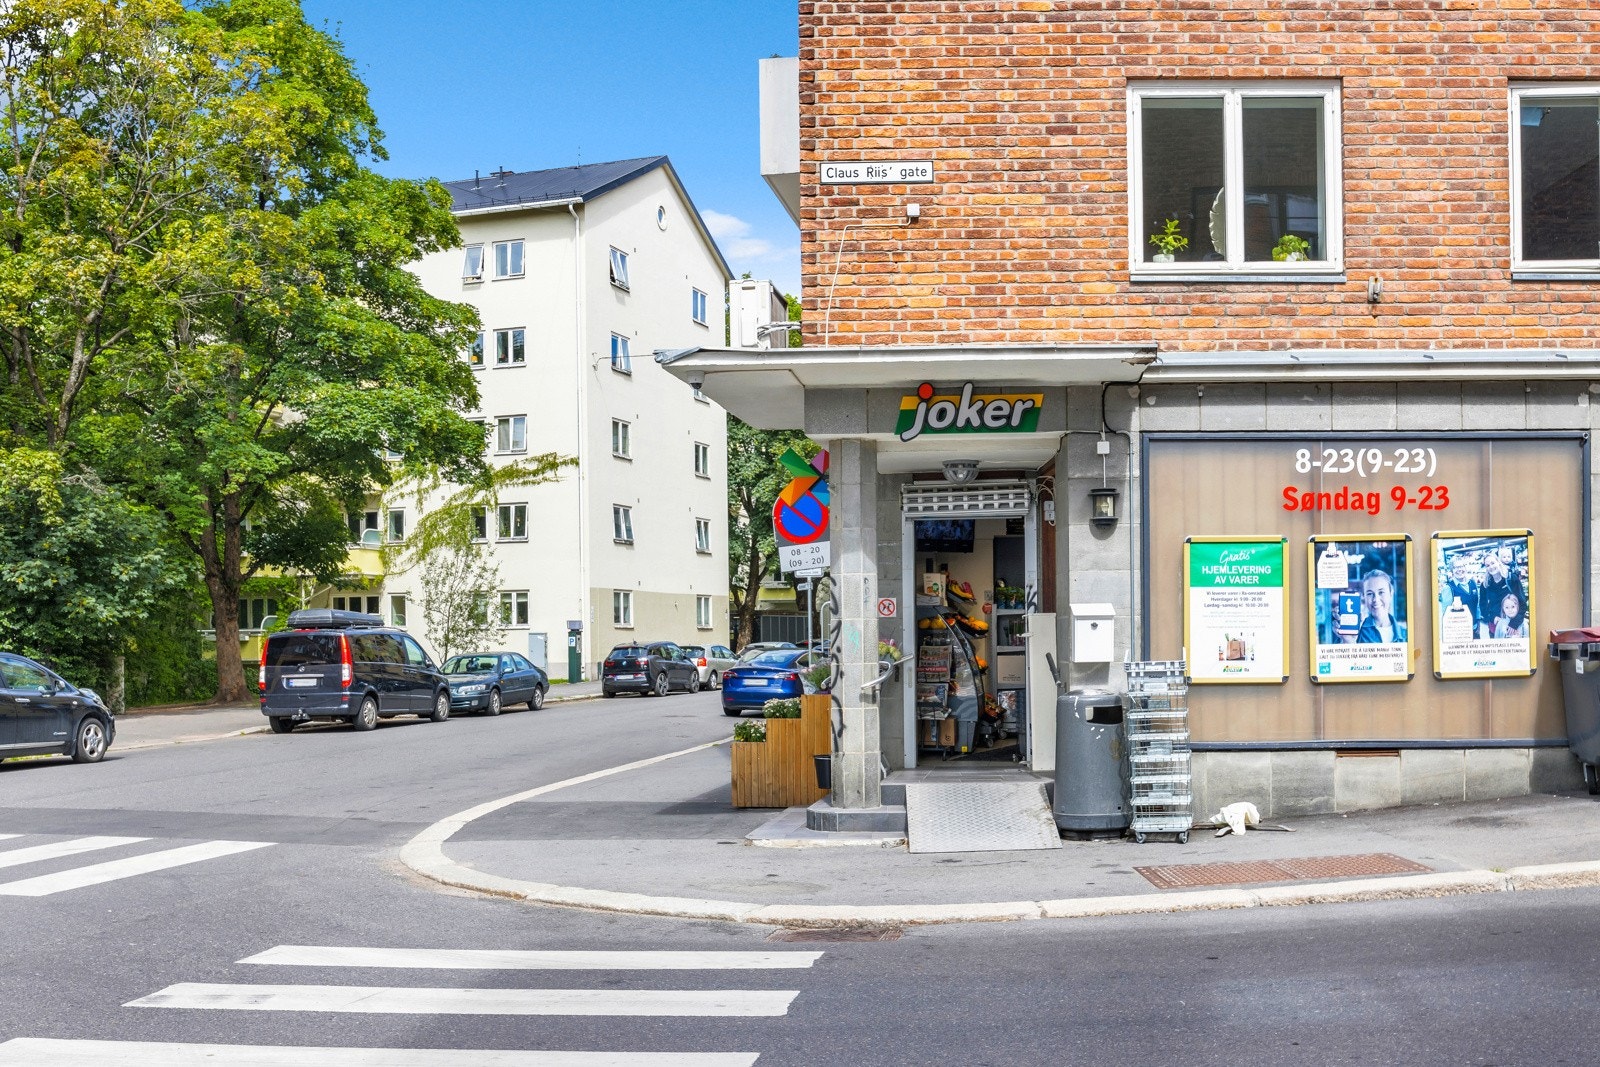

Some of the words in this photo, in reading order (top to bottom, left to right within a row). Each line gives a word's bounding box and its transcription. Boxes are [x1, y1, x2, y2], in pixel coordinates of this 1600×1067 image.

[826, 167, 859, 178] Claus
[866, 166, 893, 178] Riis'
[900, 167, 928, 179] gate
[900, 382, 1035, 442] joker
[1295, 448, 1437, 477] 8-23(9-23)
[1282, 486, 1381, 516] Søndag
[1390, 485, 1450, 511] 9-23
[810, 546, 820, 554] 20
[1202, 565, 1271, 575] HJEMLEVERING
[1214, 575, 1227, 584] AV
[1229, 575, 1260, 584] VARER
